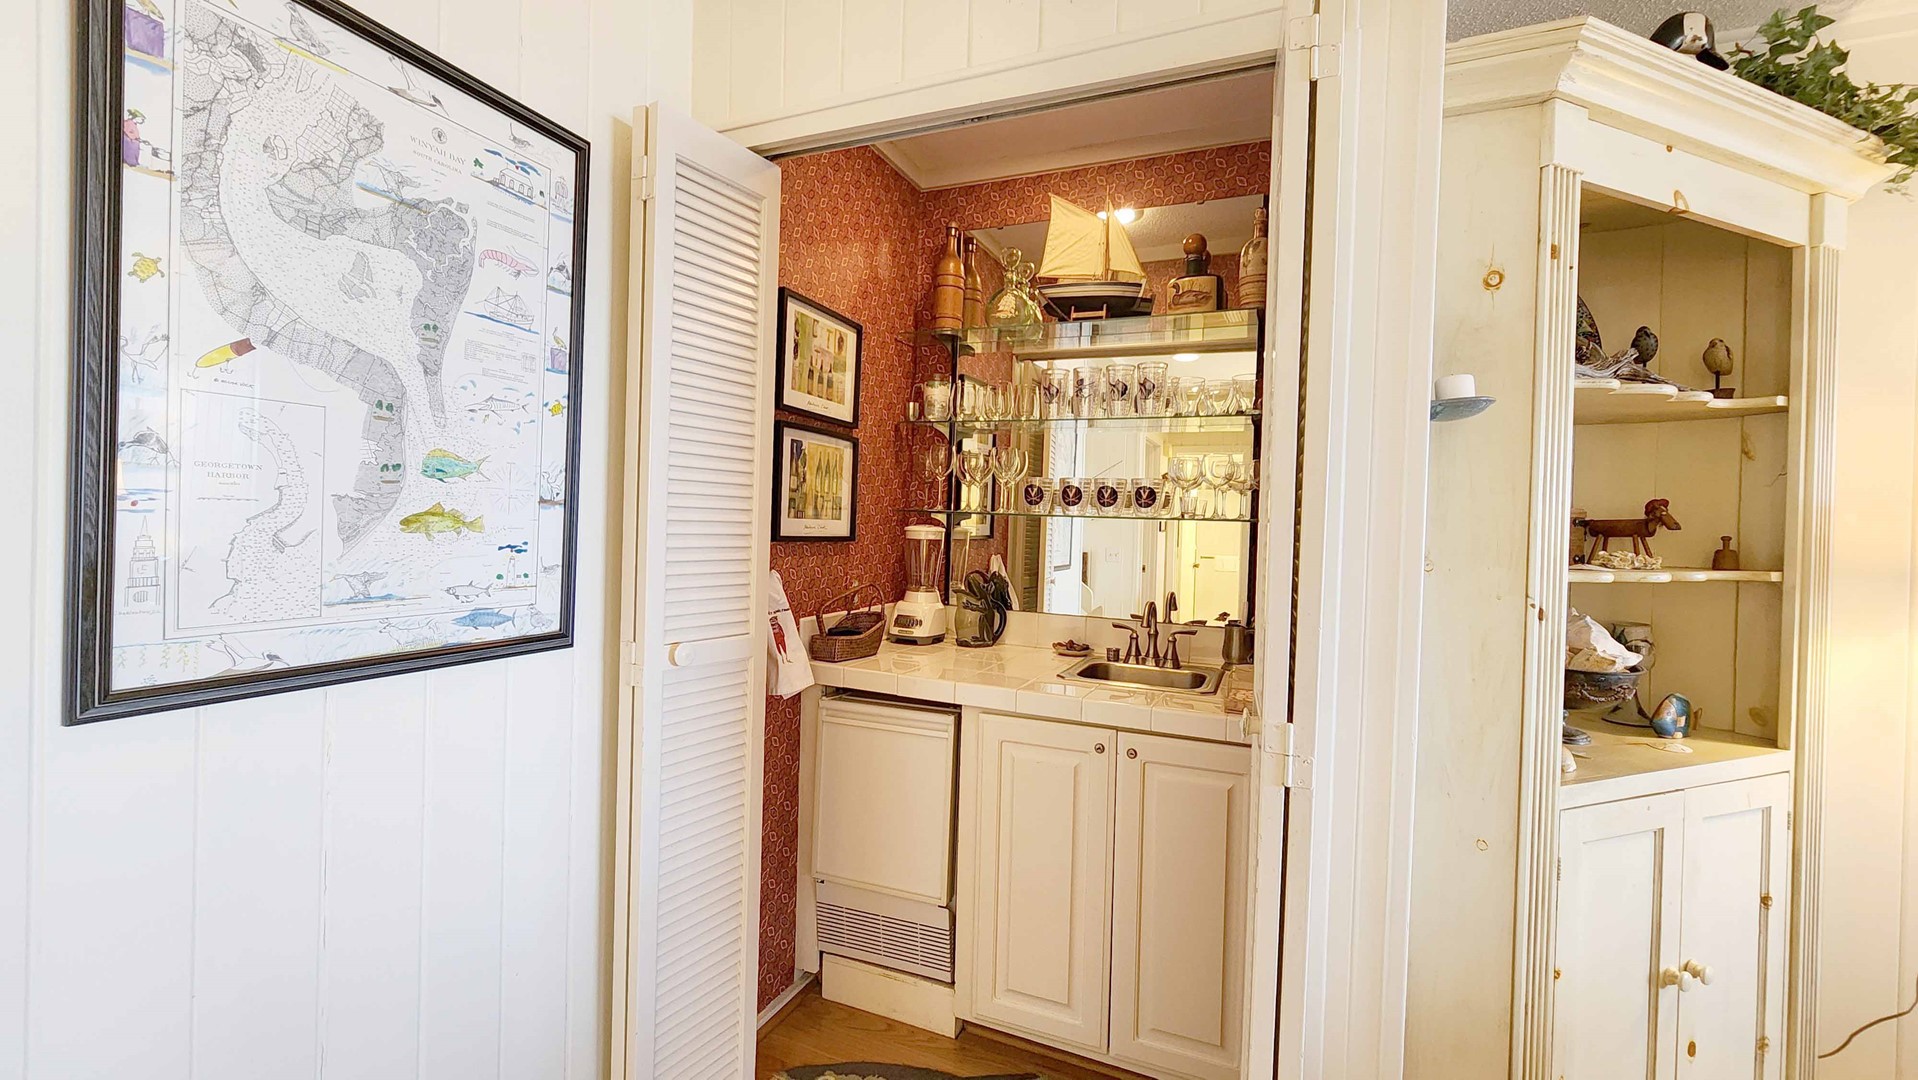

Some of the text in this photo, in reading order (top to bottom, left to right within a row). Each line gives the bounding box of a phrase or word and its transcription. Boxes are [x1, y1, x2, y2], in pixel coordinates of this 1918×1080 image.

[410, 135, 466, 165] WINYAH BAY
[193, 460, 263, 470] GEORGETOWN
[207, 471, 250, 480] HARBOR
